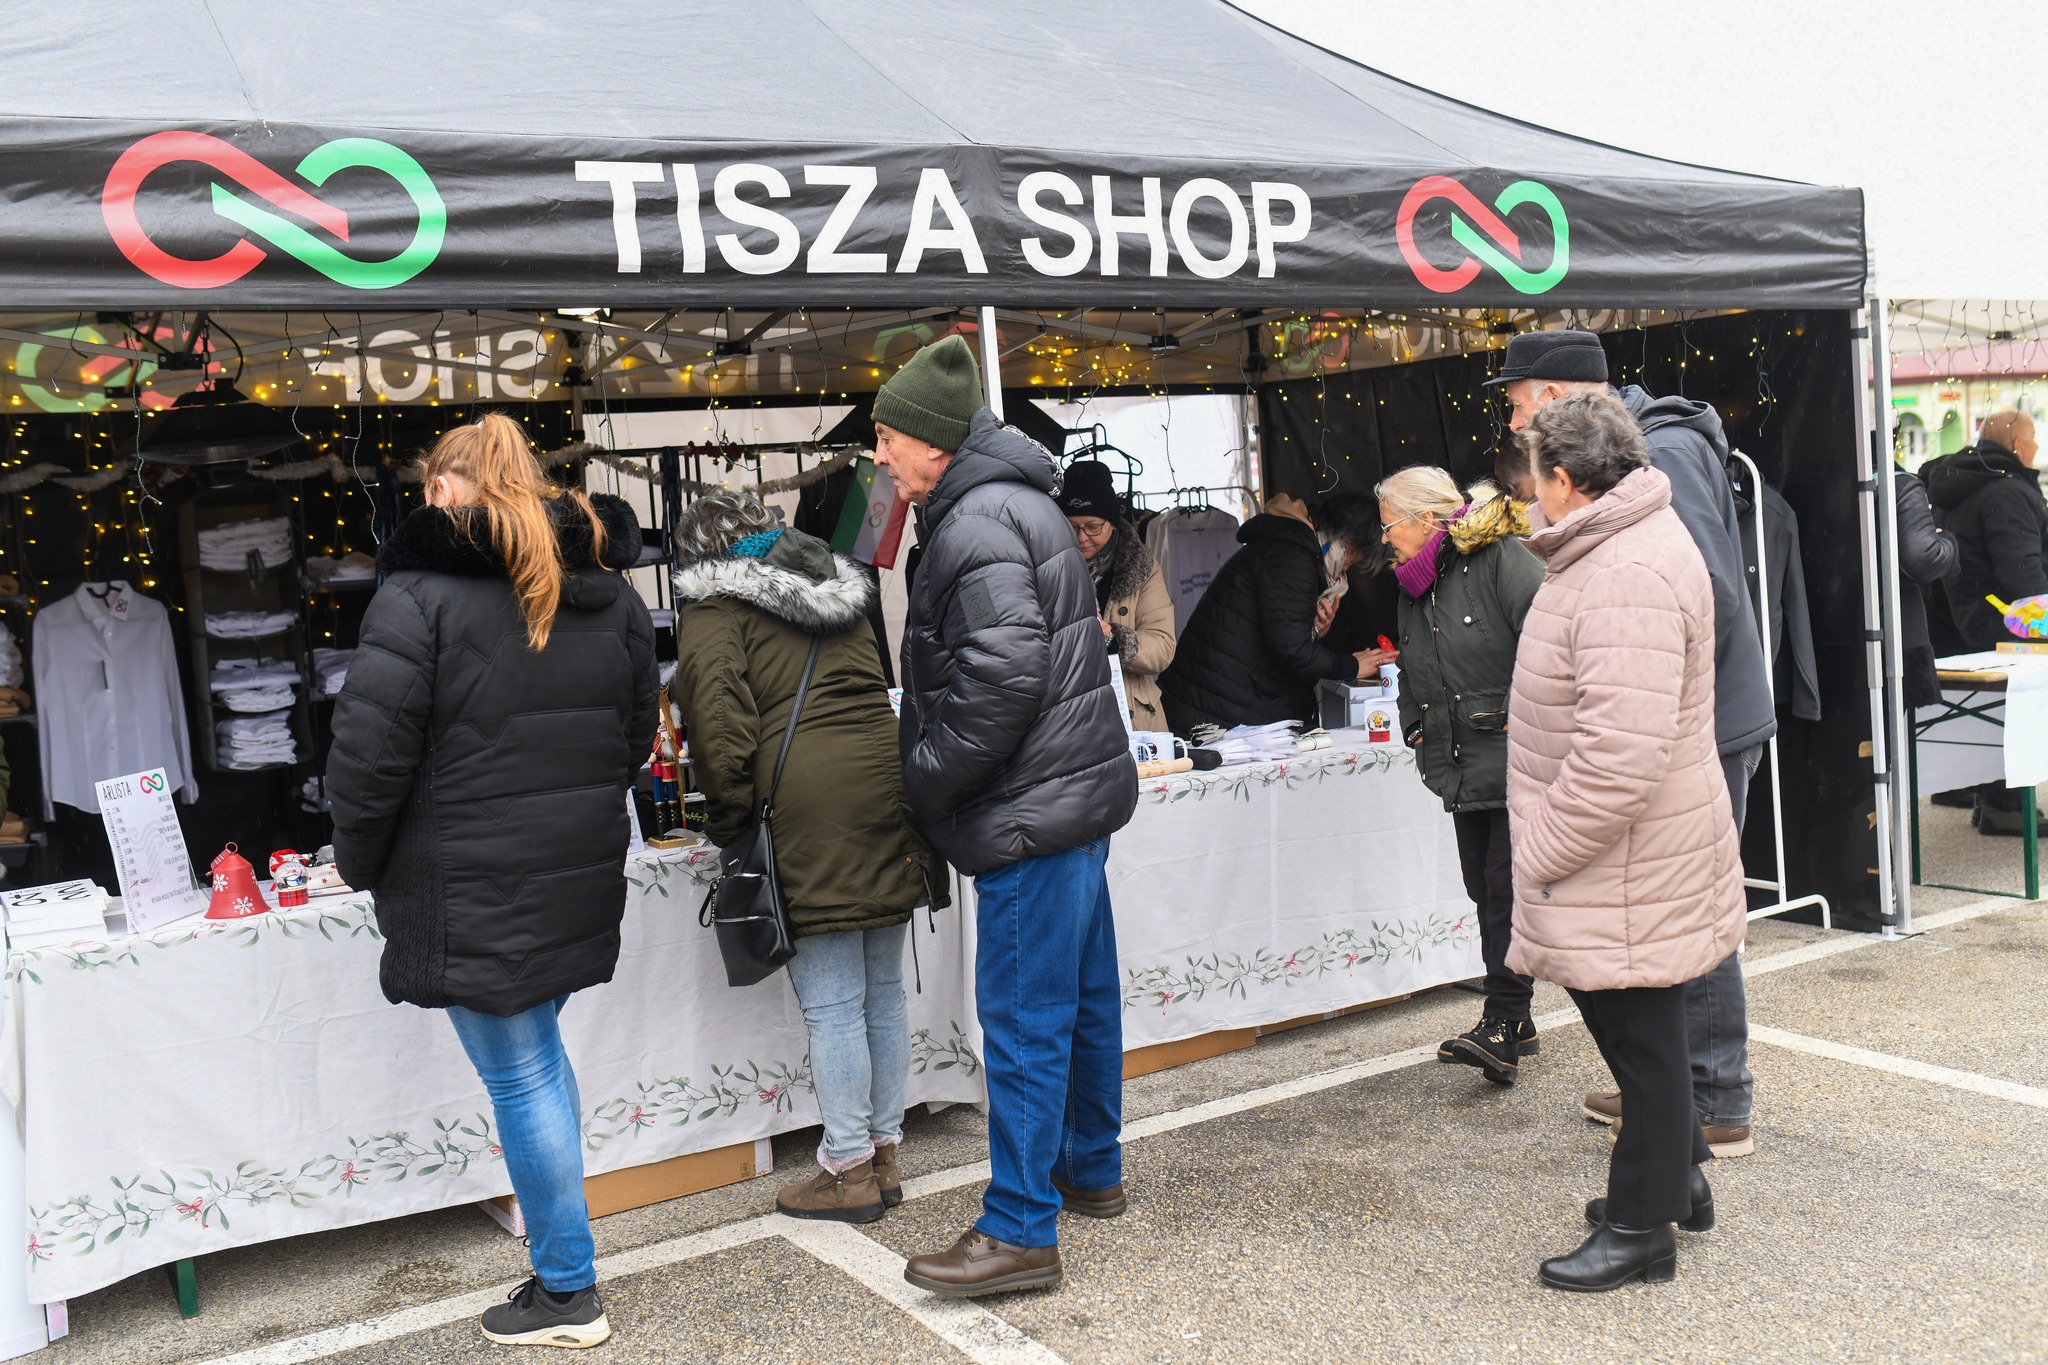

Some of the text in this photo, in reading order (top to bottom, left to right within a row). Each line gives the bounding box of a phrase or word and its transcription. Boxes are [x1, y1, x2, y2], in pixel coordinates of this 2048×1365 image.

[575, 160, 1312, 280] TISZA SHOP
[101, 781, 133, 802] ÁRLISTA
